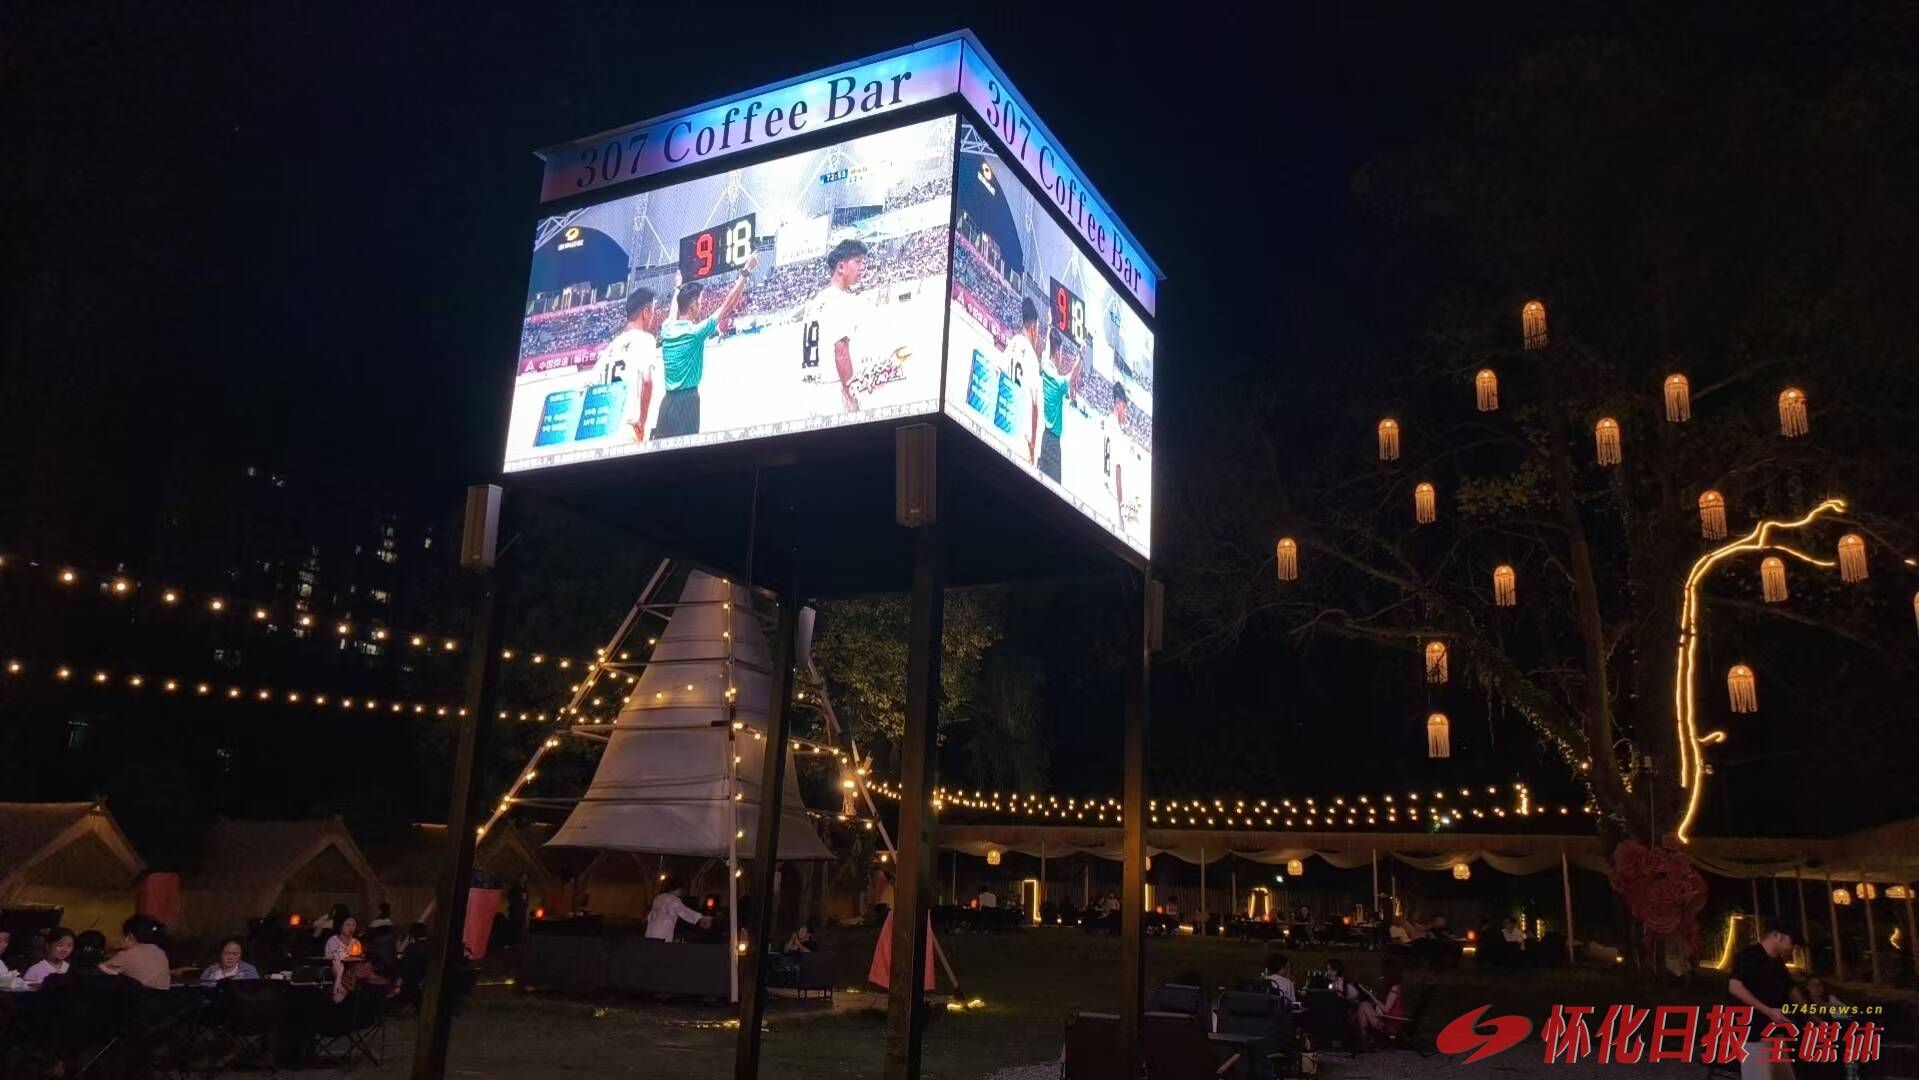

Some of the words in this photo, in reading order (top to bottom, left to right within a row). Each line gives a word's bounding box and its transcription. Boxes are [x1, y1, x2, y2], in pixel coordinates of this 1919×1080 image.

[576, 133, 648, 189] 307
[663, 101, 808, 163] Coffee
[824, 71, 912, 122] Bar
[986, 79, 1031, 160] 307
[1039, 146, 1106, 254] Coffee
[1111, 228, 1141, 294] Bar
[694, 233, 714, 277] 9
[726, 219, 752, 266] 18
[1056, 287, 1069, 332] 9
[1071, 298, 1084, 345] 18
